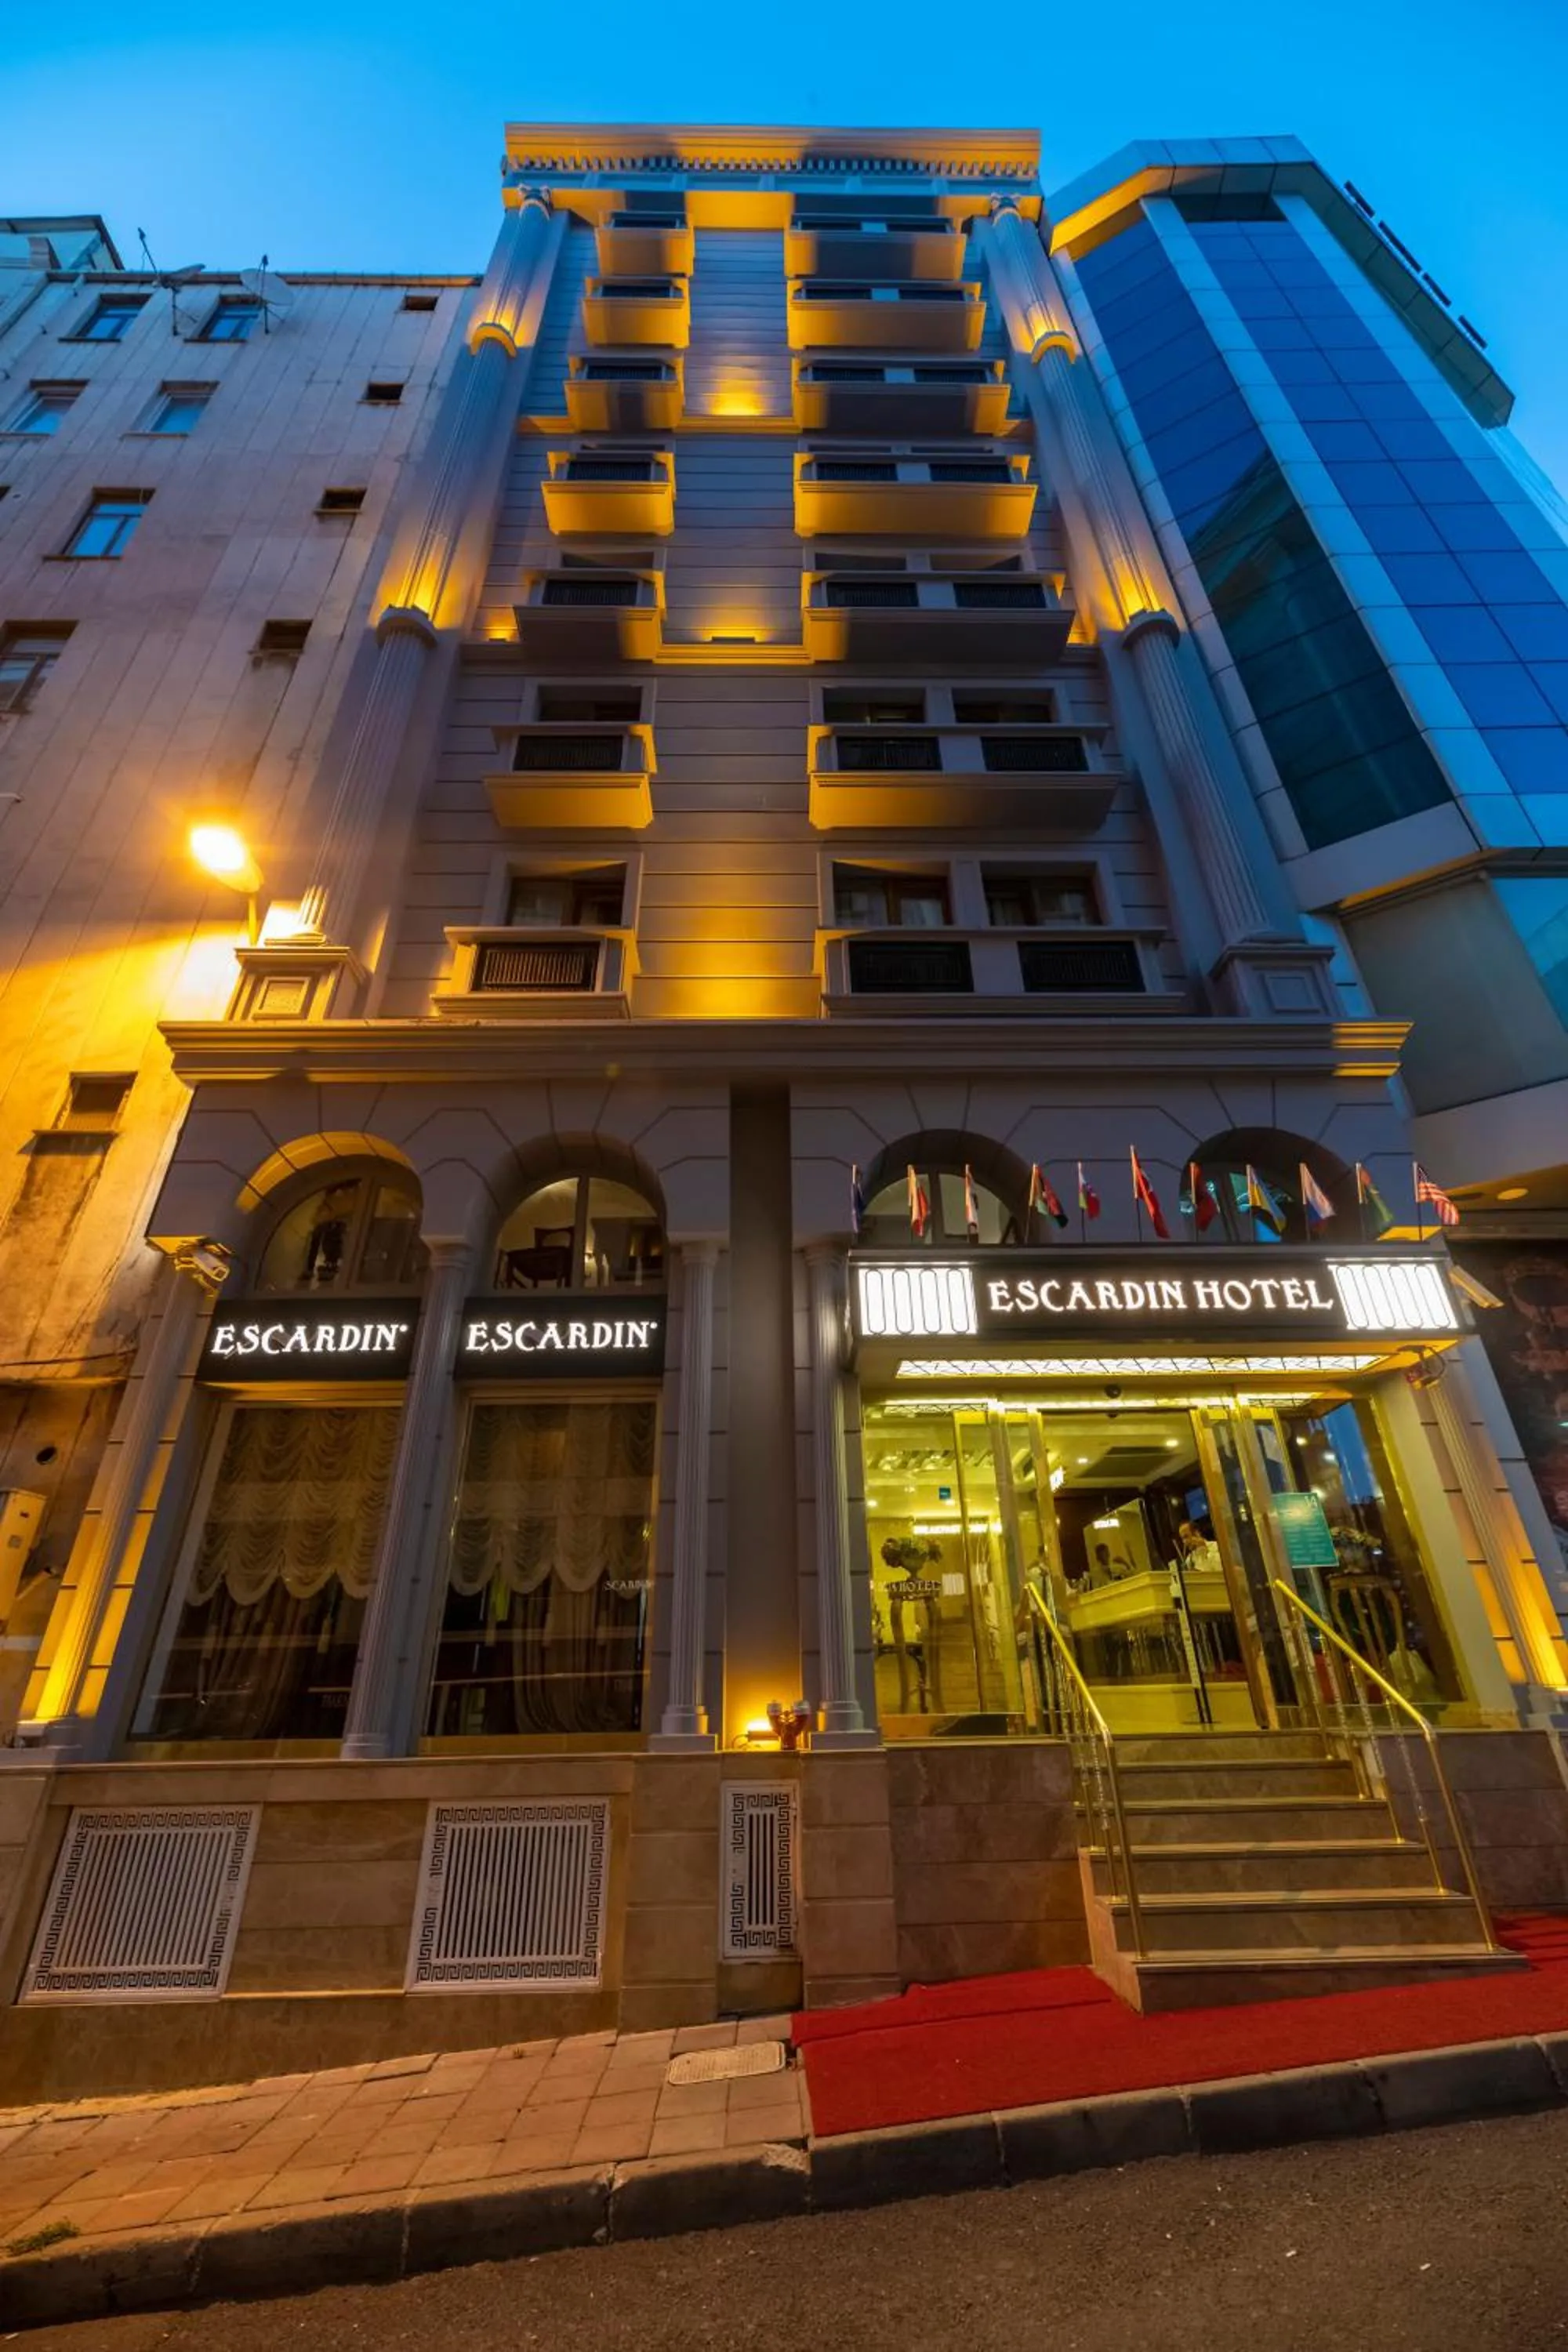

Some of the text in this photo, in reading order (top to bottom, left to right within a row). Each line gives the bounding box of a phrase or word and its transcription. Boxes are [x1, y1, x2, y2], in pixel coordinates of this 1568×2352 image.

[986, 1278, 1333, 1312] ESCARDIN HOTEL
[210, 1323, 399, 1356] ESCARDIN
[466, 1320, 649, 1352] ESCARDIN
